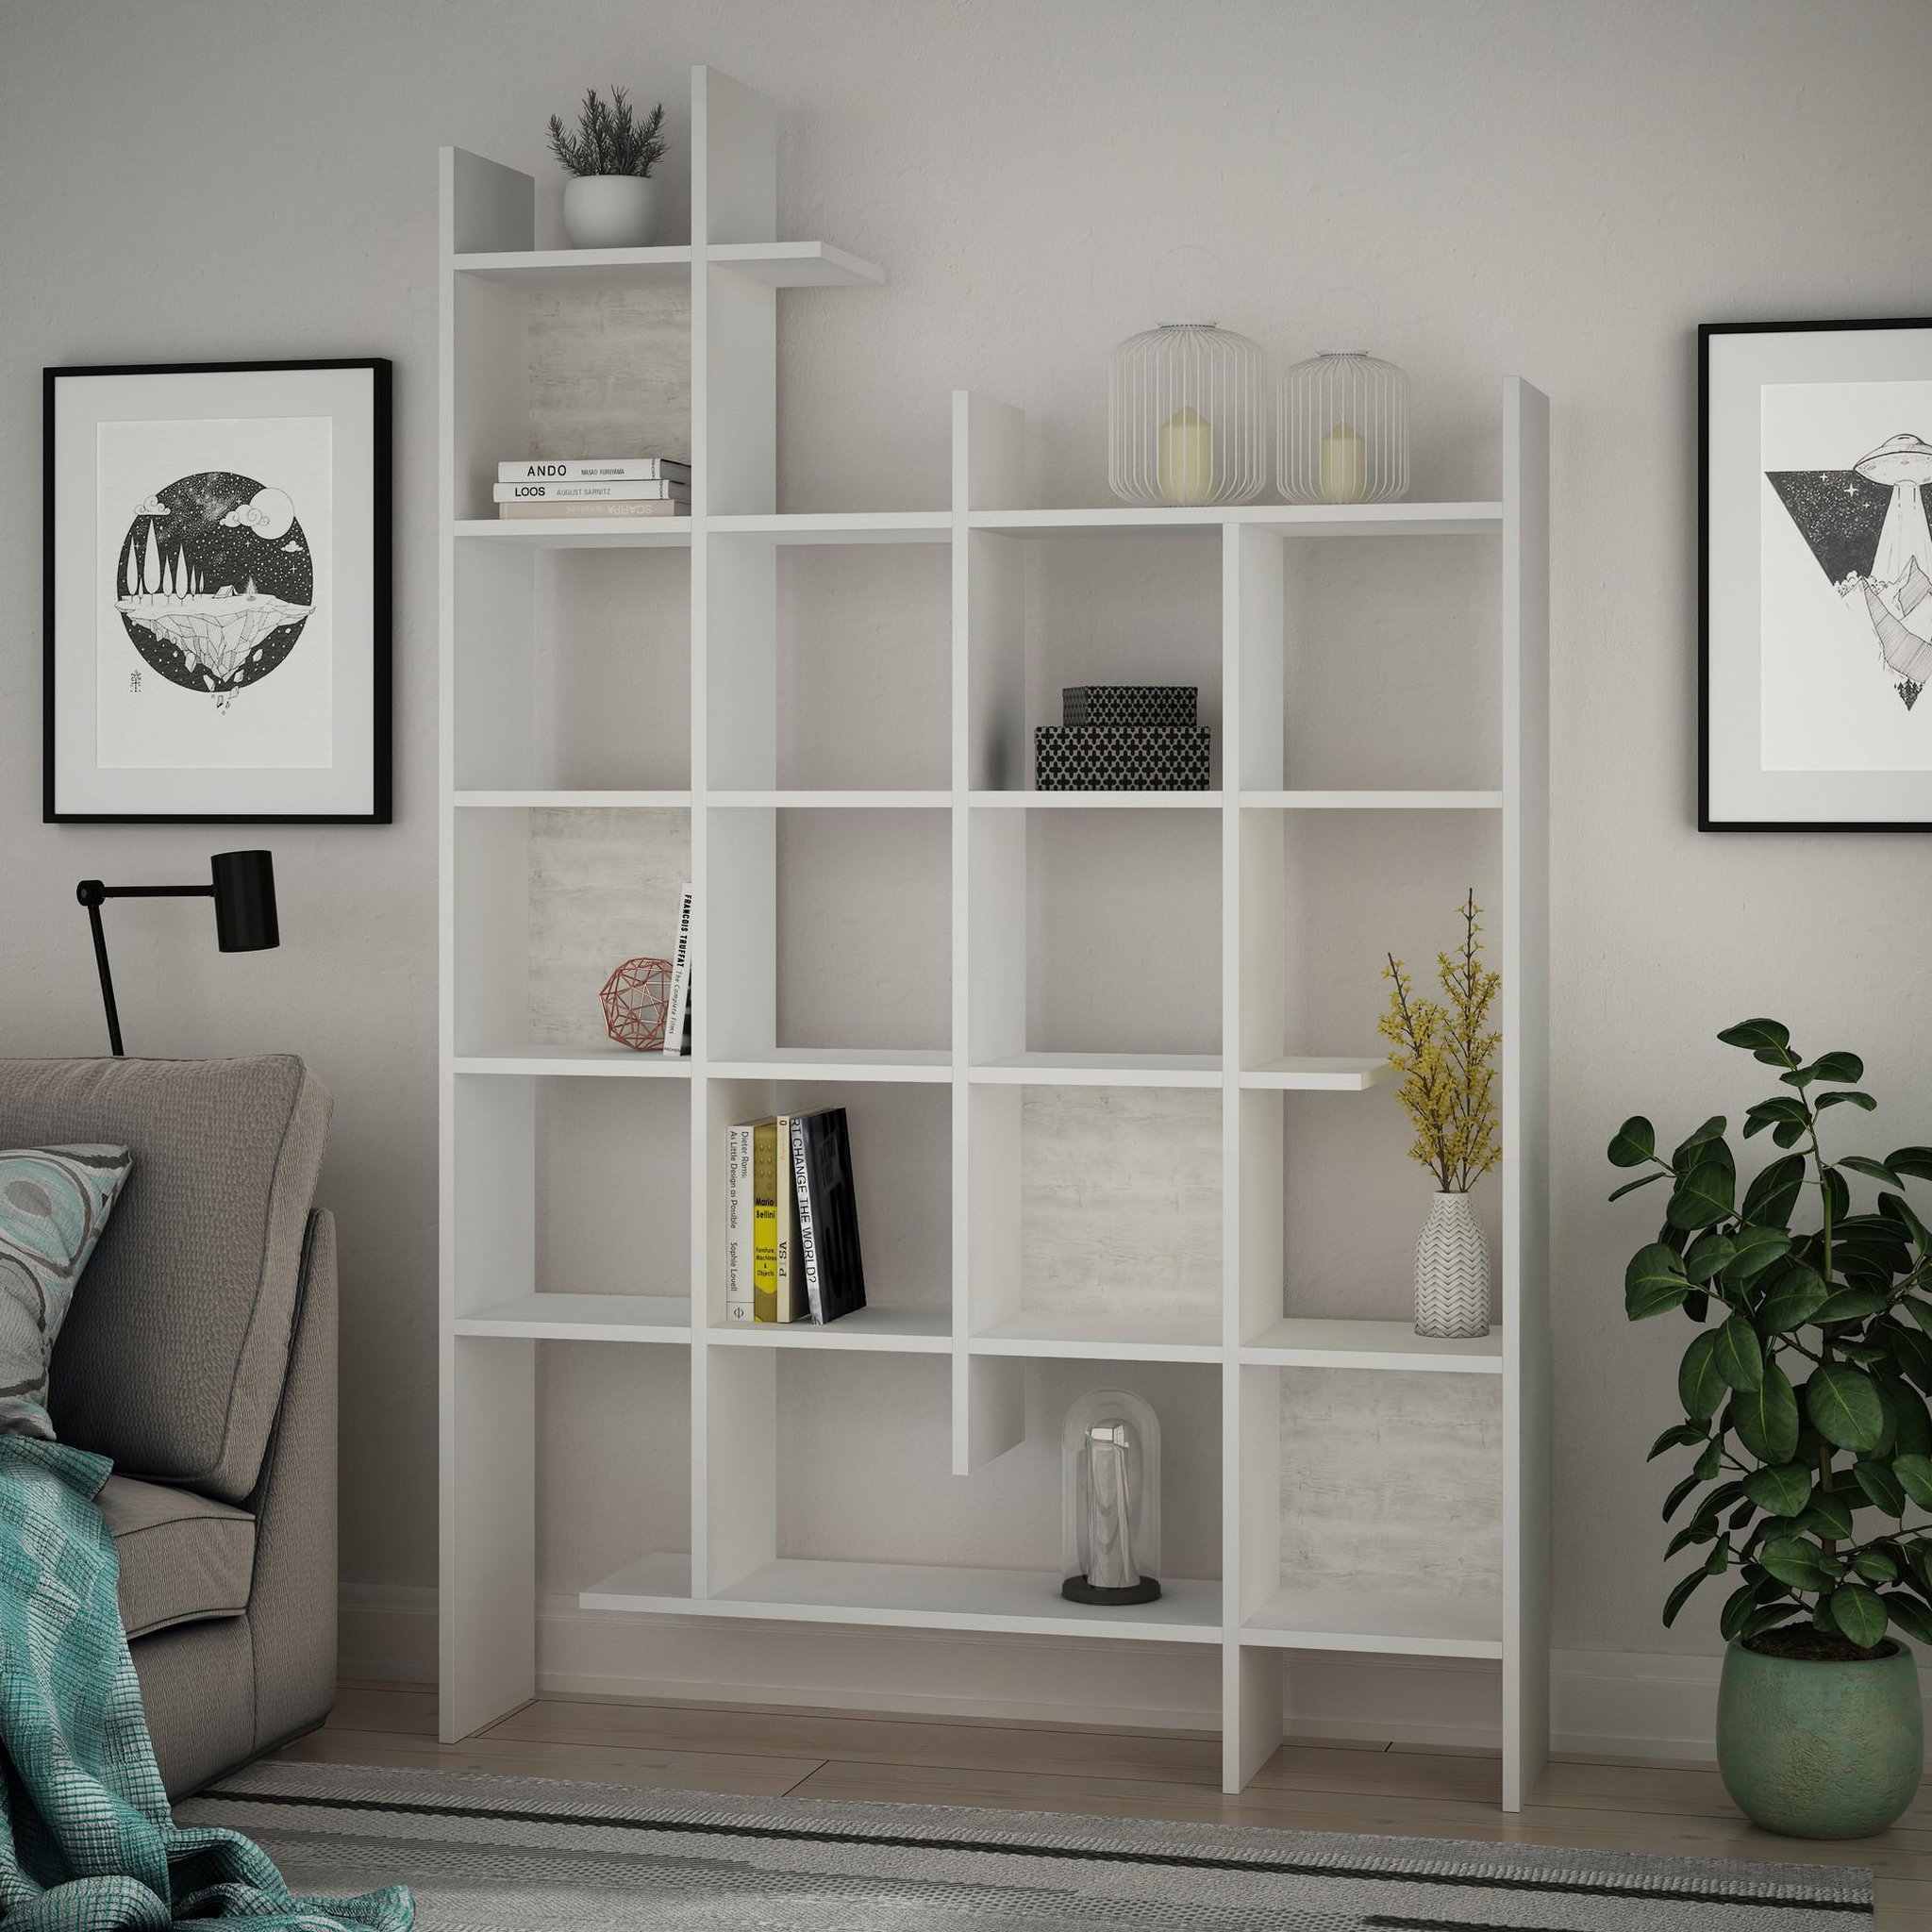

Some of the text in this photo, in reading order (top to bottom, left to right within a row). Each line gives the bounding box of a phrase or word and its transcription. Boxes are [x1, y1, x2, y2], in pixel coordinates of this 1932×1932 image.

[527, 465, 567, 477] ANDO
[515, 487, 546, 497] LOOS
[681, 894, 692, 933] FRANCOIS
[676, 936, 688, 968] TRUFFAT
[675, 972, 683, 984] The
[670, 985, 681, 1017] Complete
[668, 1018, 677, 1035] Films
[729, 1164, 738, 1189] Design
[792, 1139, 808, 1193] CHANGE
[757, 1198, 774, 1207] Mario
[757, 1210, 775, 1219] Bellini
[799, 1197, 811, 1224] THE
[729, 1242, 738, 1268] Sophie
[803, 1227, 818, 1284] WORLD?
